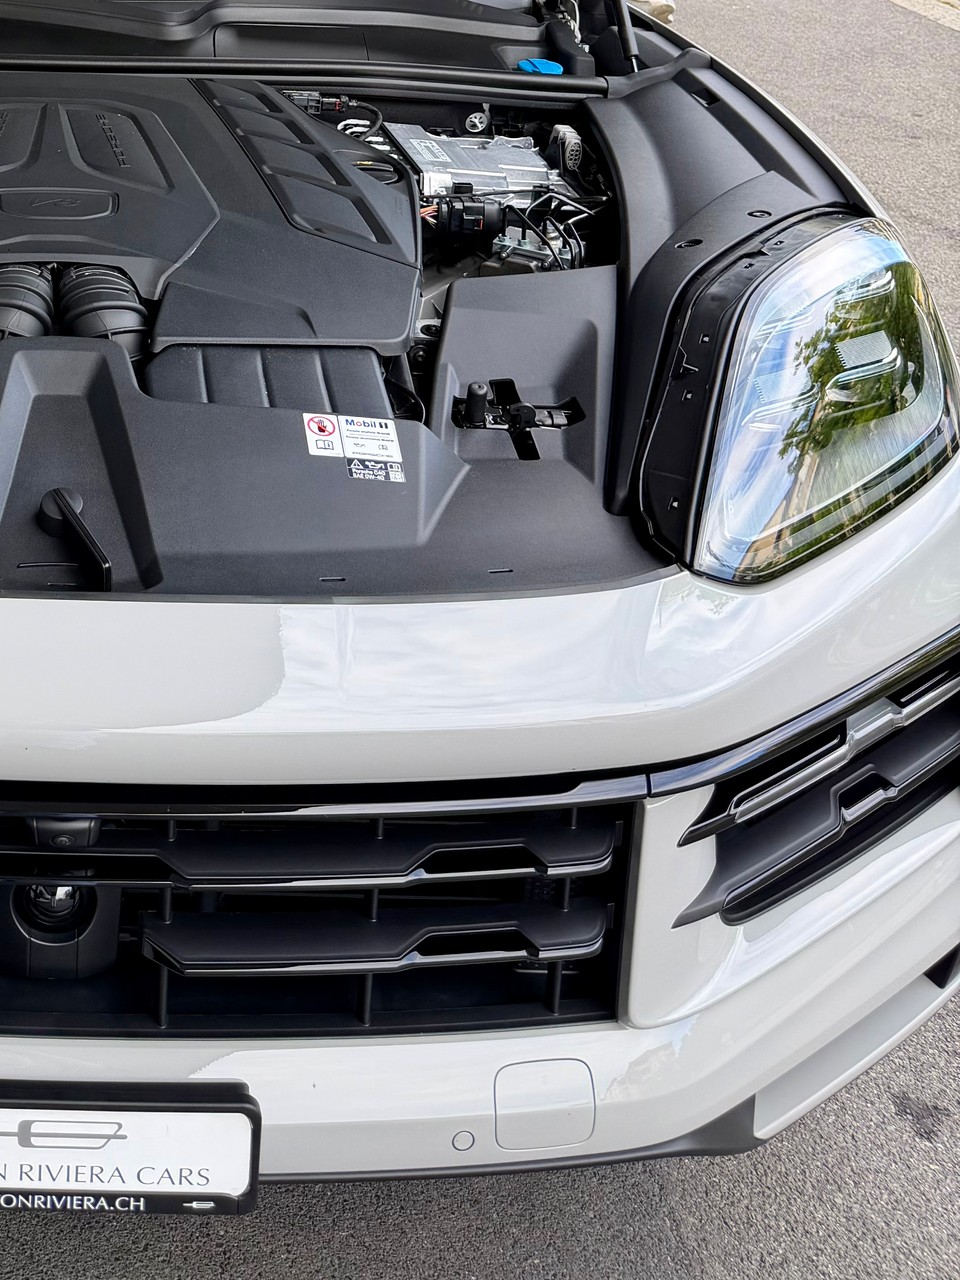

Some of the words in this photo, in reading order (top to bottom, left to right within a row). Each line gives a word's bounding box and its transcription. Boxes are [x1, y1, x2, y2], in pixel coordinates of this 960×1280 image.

[345, 419, 376, 428] Mobil
[19, 1163, 126, 1184] RIVIERA
[136, 1166, 211, 1187] CARS
